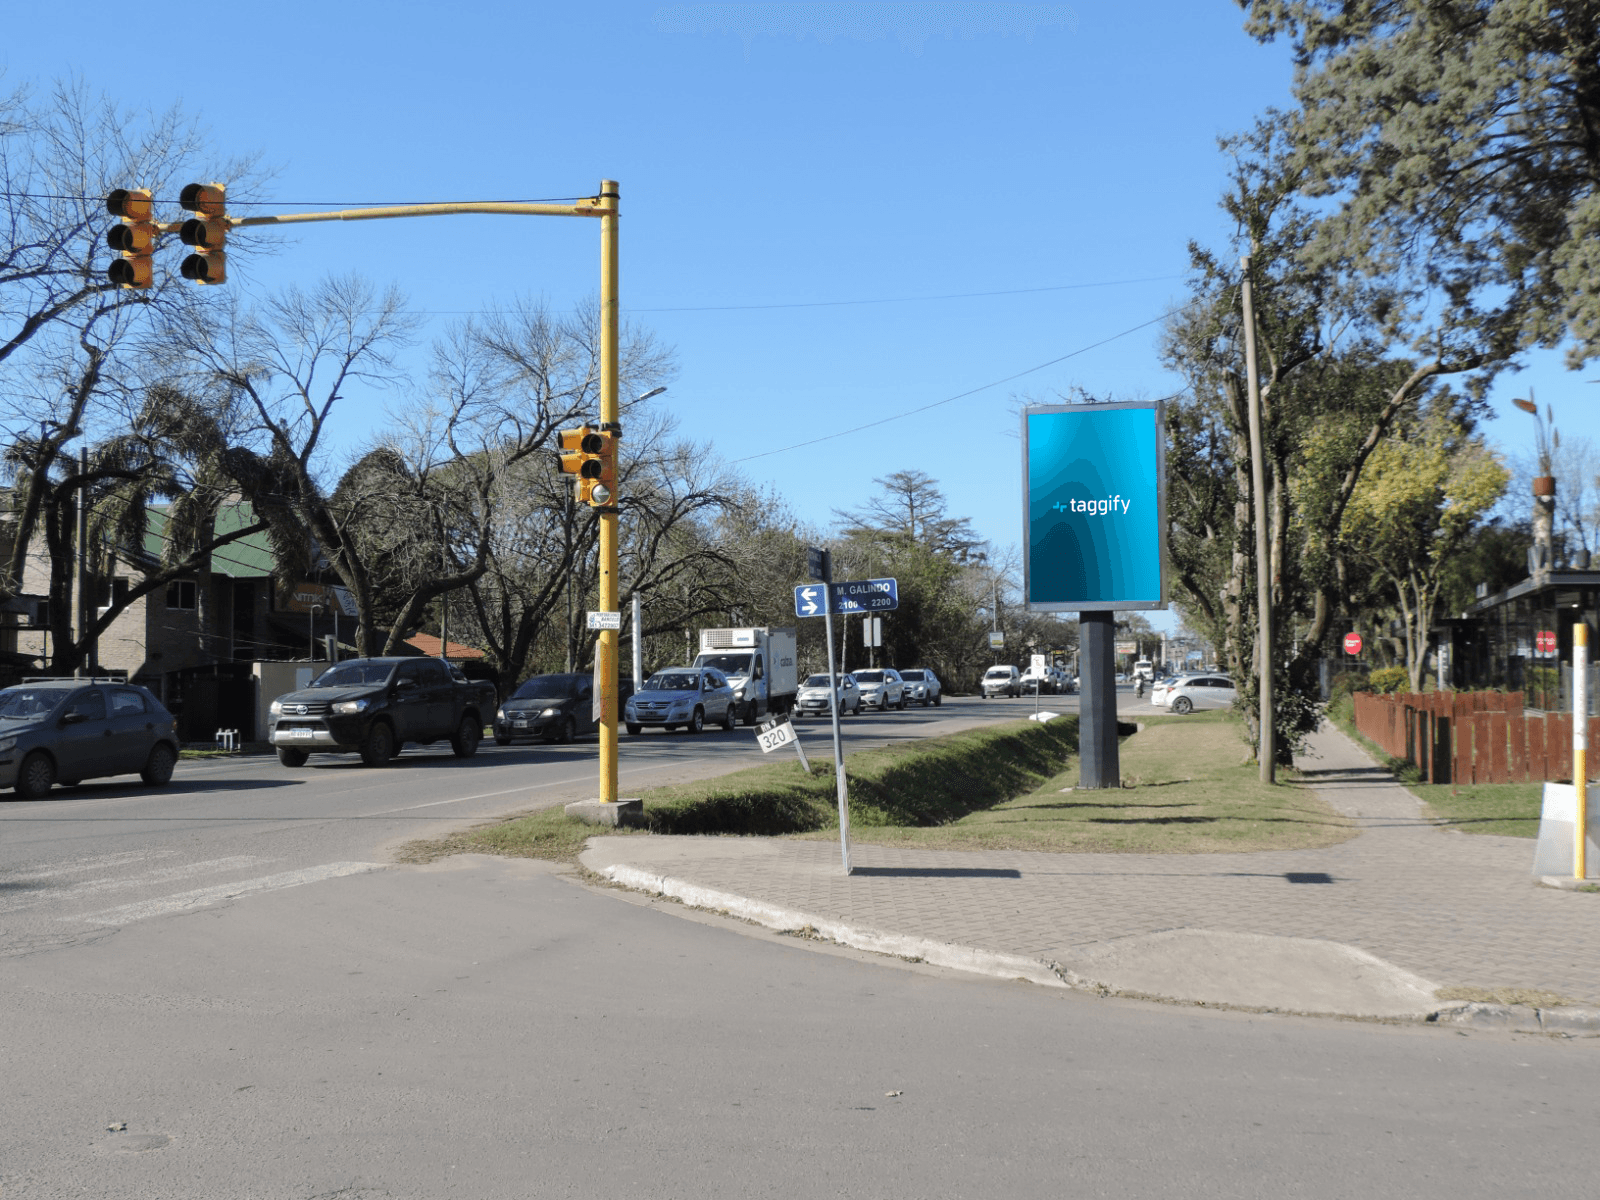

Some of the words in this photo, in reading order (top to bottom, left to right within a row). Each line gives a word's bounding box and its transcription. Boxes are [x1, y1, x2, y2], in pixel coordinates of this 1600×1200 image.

[1070, 495, 1131, 516] taggify
[836, 586, 847, 596] M.
[849, 582, 891, 595] GALINDO
[838, 600, 859, 610] 2100
[871, 597, 891, 608] 2200
[760, 722, 772, 733] RN
[770, 719, 777, 728] 9
[763, 729, 786, 749] 320
